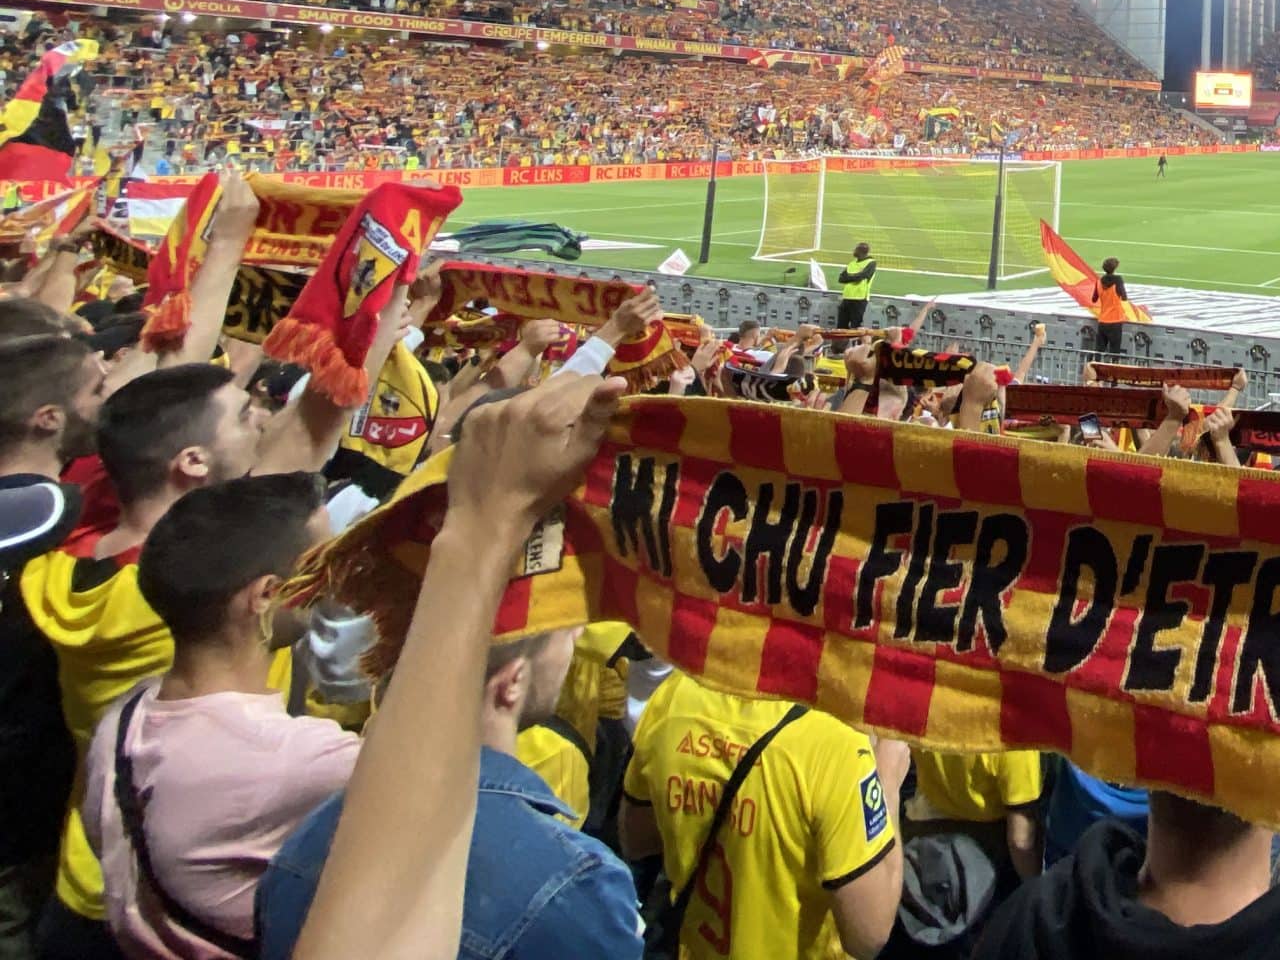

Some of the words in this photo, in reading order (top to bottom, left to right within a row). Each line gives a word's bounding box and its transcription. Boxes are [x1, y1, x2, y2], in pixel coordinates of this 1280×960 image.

[188, 0, 242, 15] VEOLIA
[298, 9, 348, 24] SMART
[352, 14, 394, 26] GOOD
[398, 18, 446, 31] THINGS
[481, 24, 533, 40] GROUPE
[536, 30, 607, 46] LEMPEREUR
[635, 38, 677, 52] WINAMAX
[684, 41, 722, 55] WINAMAX
[438, 171, 471, 185] LENS
[509, 169, 531, 184] RC
[534, 167, 563, 183] LENS
[596, 167, 615, 180] RC
[616, 166, 642, 179] LENS
[671, 166, 686, 178] RC
[689, 164, 712, 177] LENS
[325, 174, 365, 189] LENS
[610, 452, 681, 580] MI
[695, 470, 845, 617] CHU
[853, 500, 1030, 656] FIER
